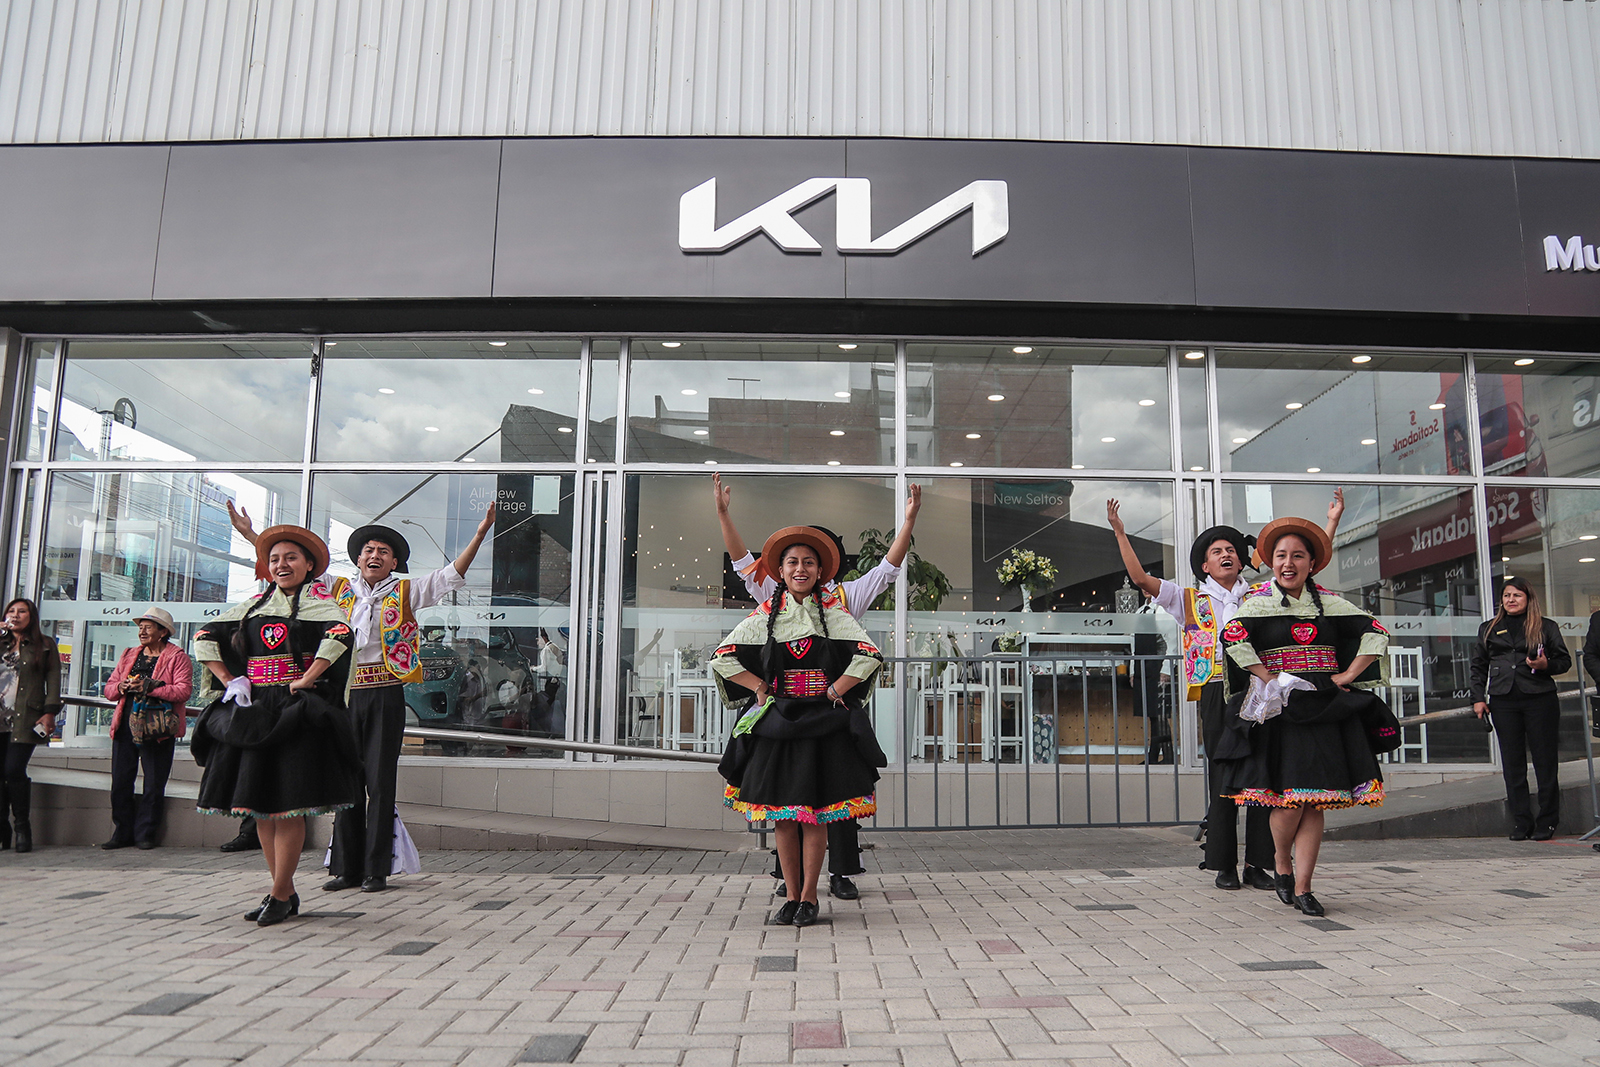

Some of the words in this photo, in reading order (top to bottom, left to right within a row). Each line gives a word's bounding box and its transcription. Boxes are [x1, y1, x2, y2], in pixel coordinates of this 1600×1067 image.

[678, 176, 1010, 257] KIA
[1543, 235, 1600, 271] Mu
[469, 487, 517, 499] All-new
[993, 493, 1023, 505] New
[1025, 492, 1064, 506] Seltos
[469, 499, 527, 514] Sportage
[102, 607, 131, 615] KIA
[203, 608, 221, 617] KI
[477, 612, 506, 621] KIA
[976, 618, 1006, 626] KIA
[1083, 618, 1114, 627] KIA
[1395, 622, 1423, 630] KIA
